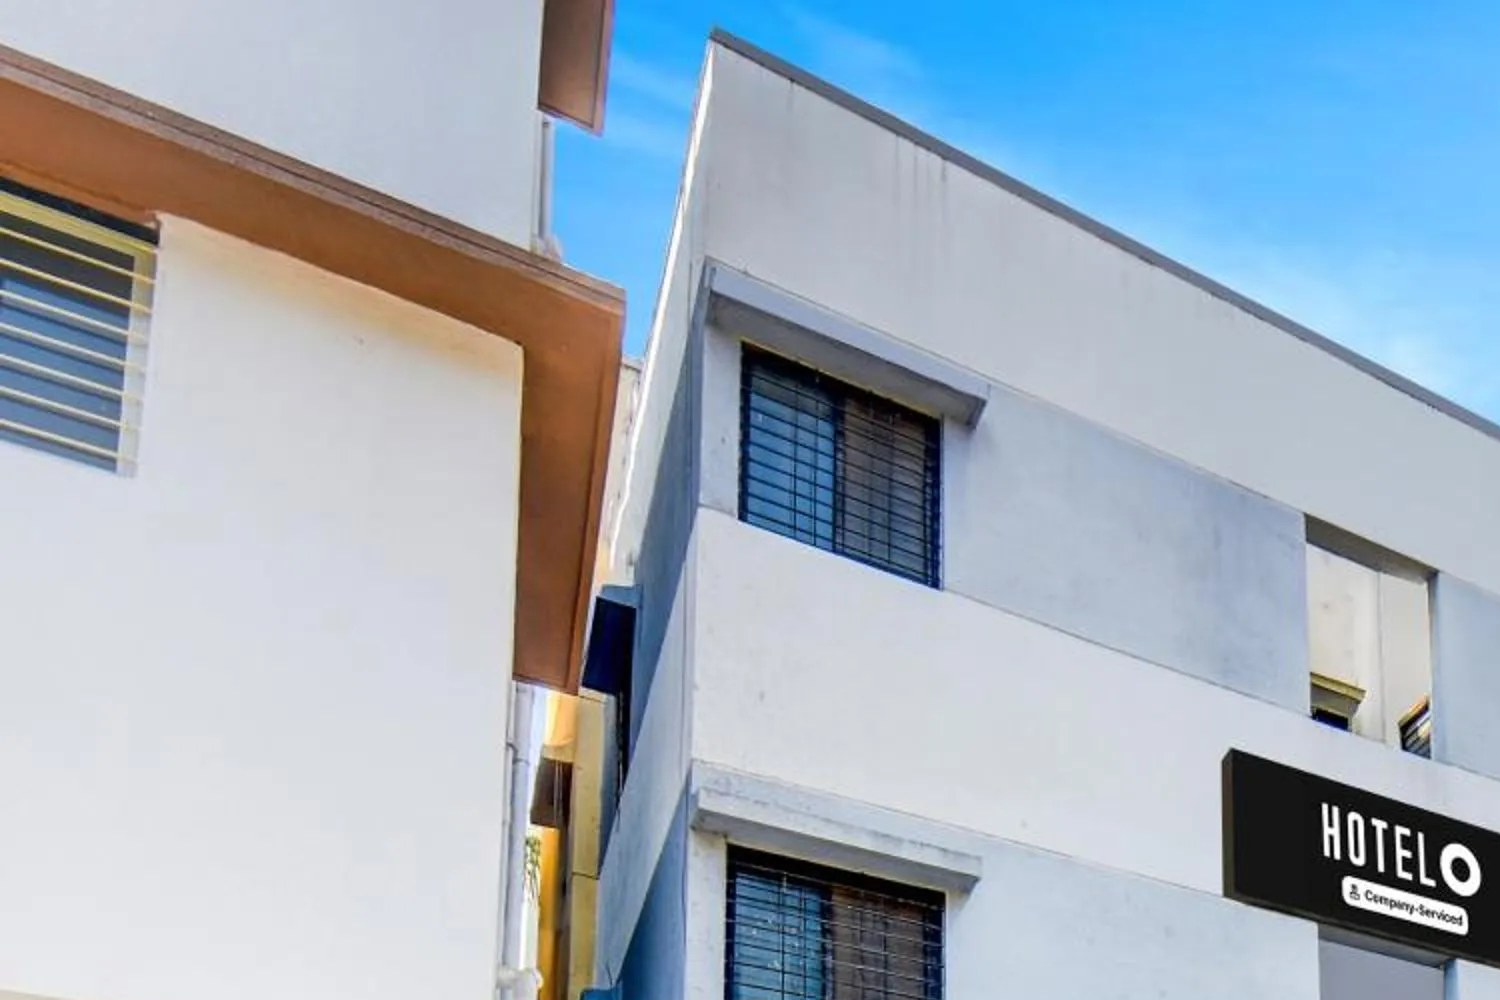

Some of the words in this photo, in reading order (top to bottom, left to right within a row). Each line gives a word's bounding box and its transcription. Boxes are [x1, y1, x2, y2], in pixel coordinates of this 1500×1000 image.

[1321, 802, 1436, 887] HOTEL
[1440, 842, 1482, 897] O
[1364, 889, 1464, 926] Company-Serviced
